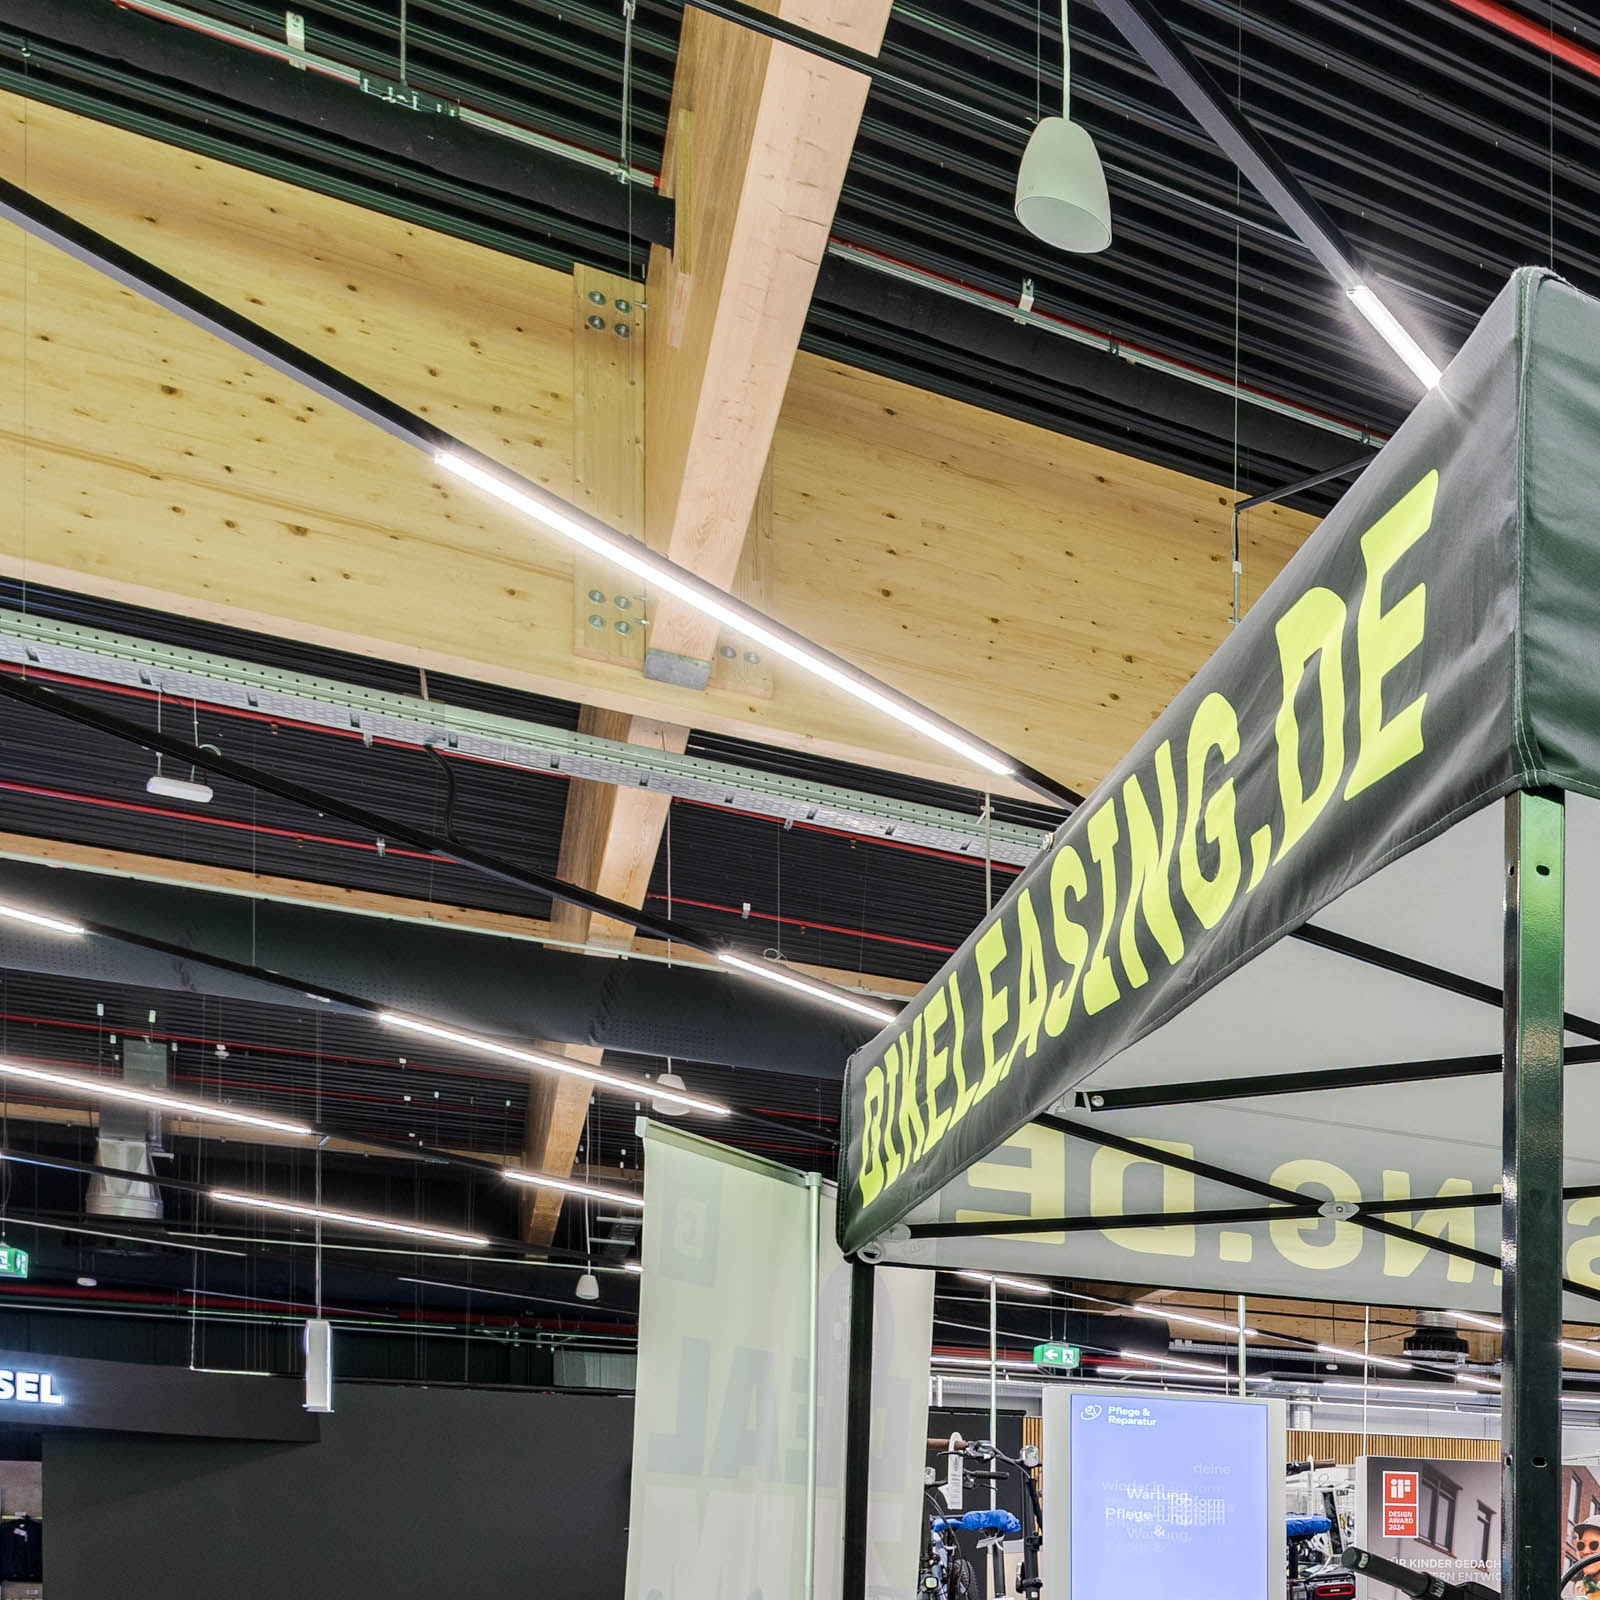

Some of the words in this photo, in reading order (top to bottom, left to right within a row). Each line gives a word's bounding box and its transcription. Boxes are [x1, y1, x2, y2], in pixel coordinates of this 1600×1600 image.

[862, 469, 1440, 1208] BIKELEASING.DE
[1108, 1406, 1140, 1418] Pflege
[1142, 1408, 1152, 1416] &
[1108, 1416, 1158, 1426] Reparatur
[1388, 1510, 1412, 1518] DESIGN
[1390, 1556, 1408, 1568] ÜR
[1409, 1559, 1452, 1570] KINDER
[1455, 1559, 1502, 1570] GEDACH
